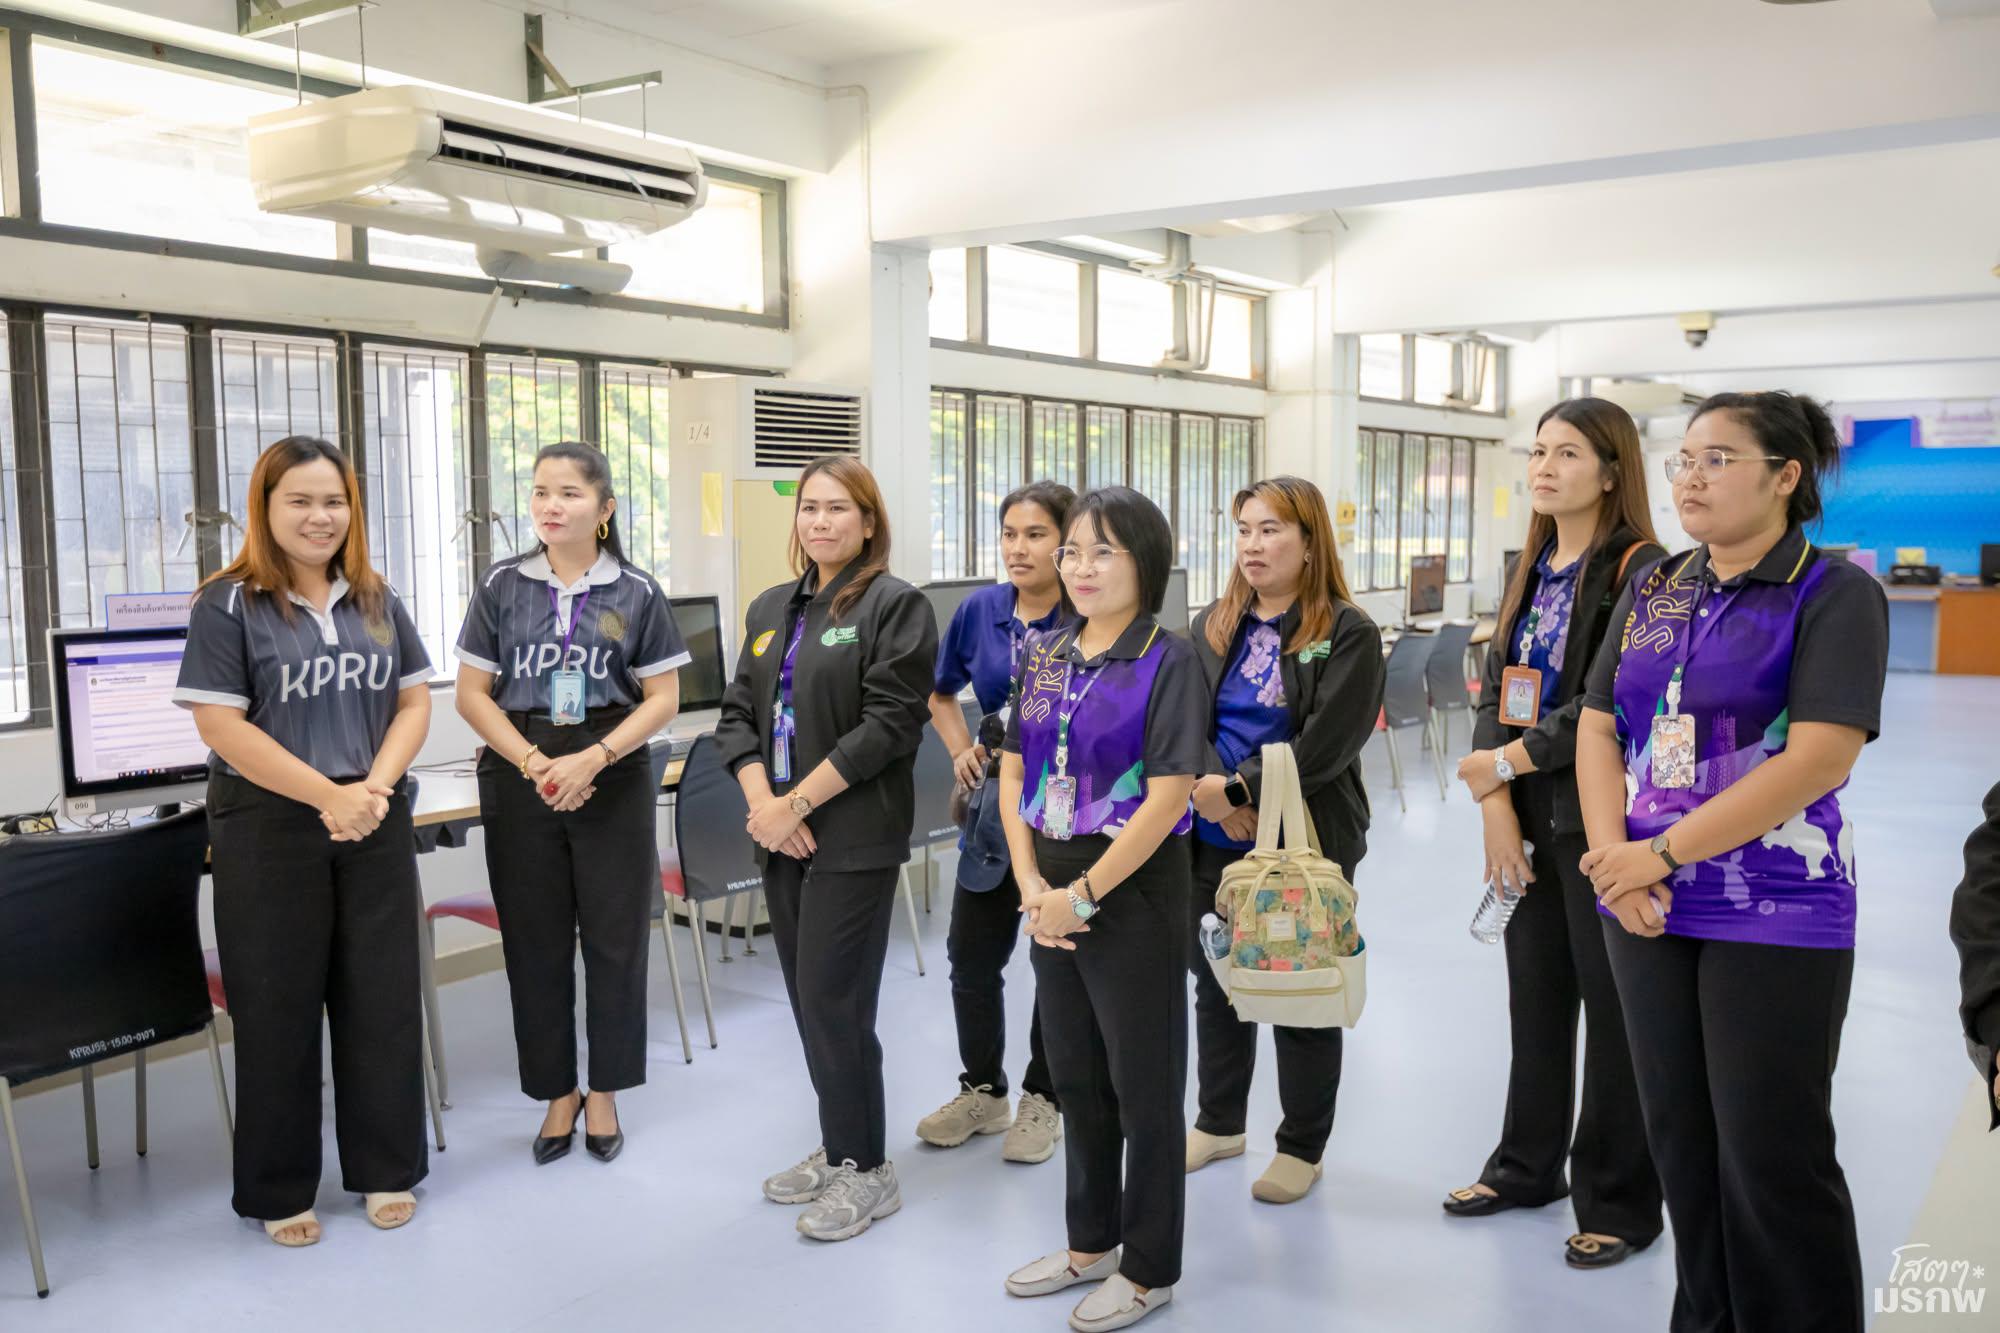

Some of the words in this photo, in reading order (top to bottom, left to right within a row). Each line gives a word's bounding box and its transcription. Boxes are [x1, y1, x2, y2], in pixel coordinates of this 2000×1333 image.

[688, 424, 710, 442] 1/4
[281, 652, 393, 703] KPRU
[514, 643, 613, 680] KPRU
